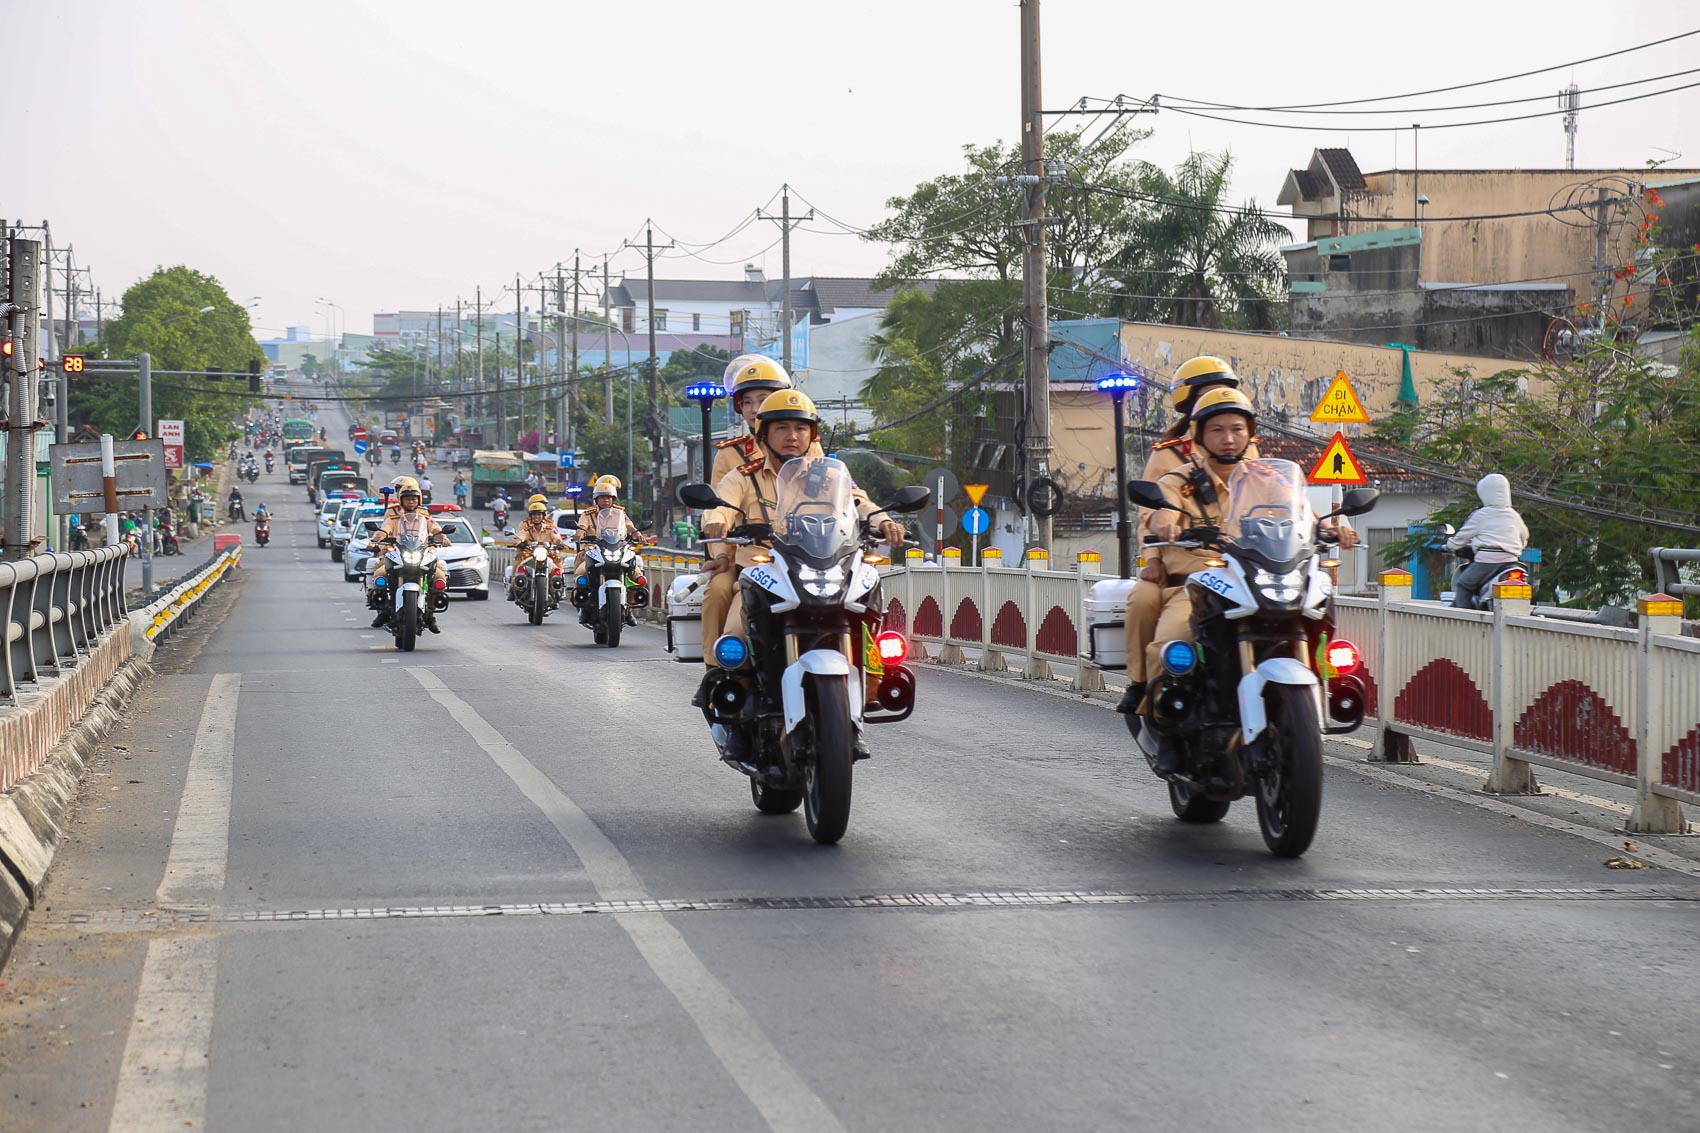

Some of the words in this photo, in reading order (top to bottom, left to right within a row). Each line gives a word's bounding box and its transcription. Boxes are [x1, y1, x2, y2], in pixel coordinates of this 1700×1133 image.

[64, 357, 83, 372] 28
[1335, 390, 1347, 400] ĐI
[1323, 402, 1357, 417] CHẬM
[750, 567, 778, 590] CSGT
[1200, 572, 1233, 595] CSGT
